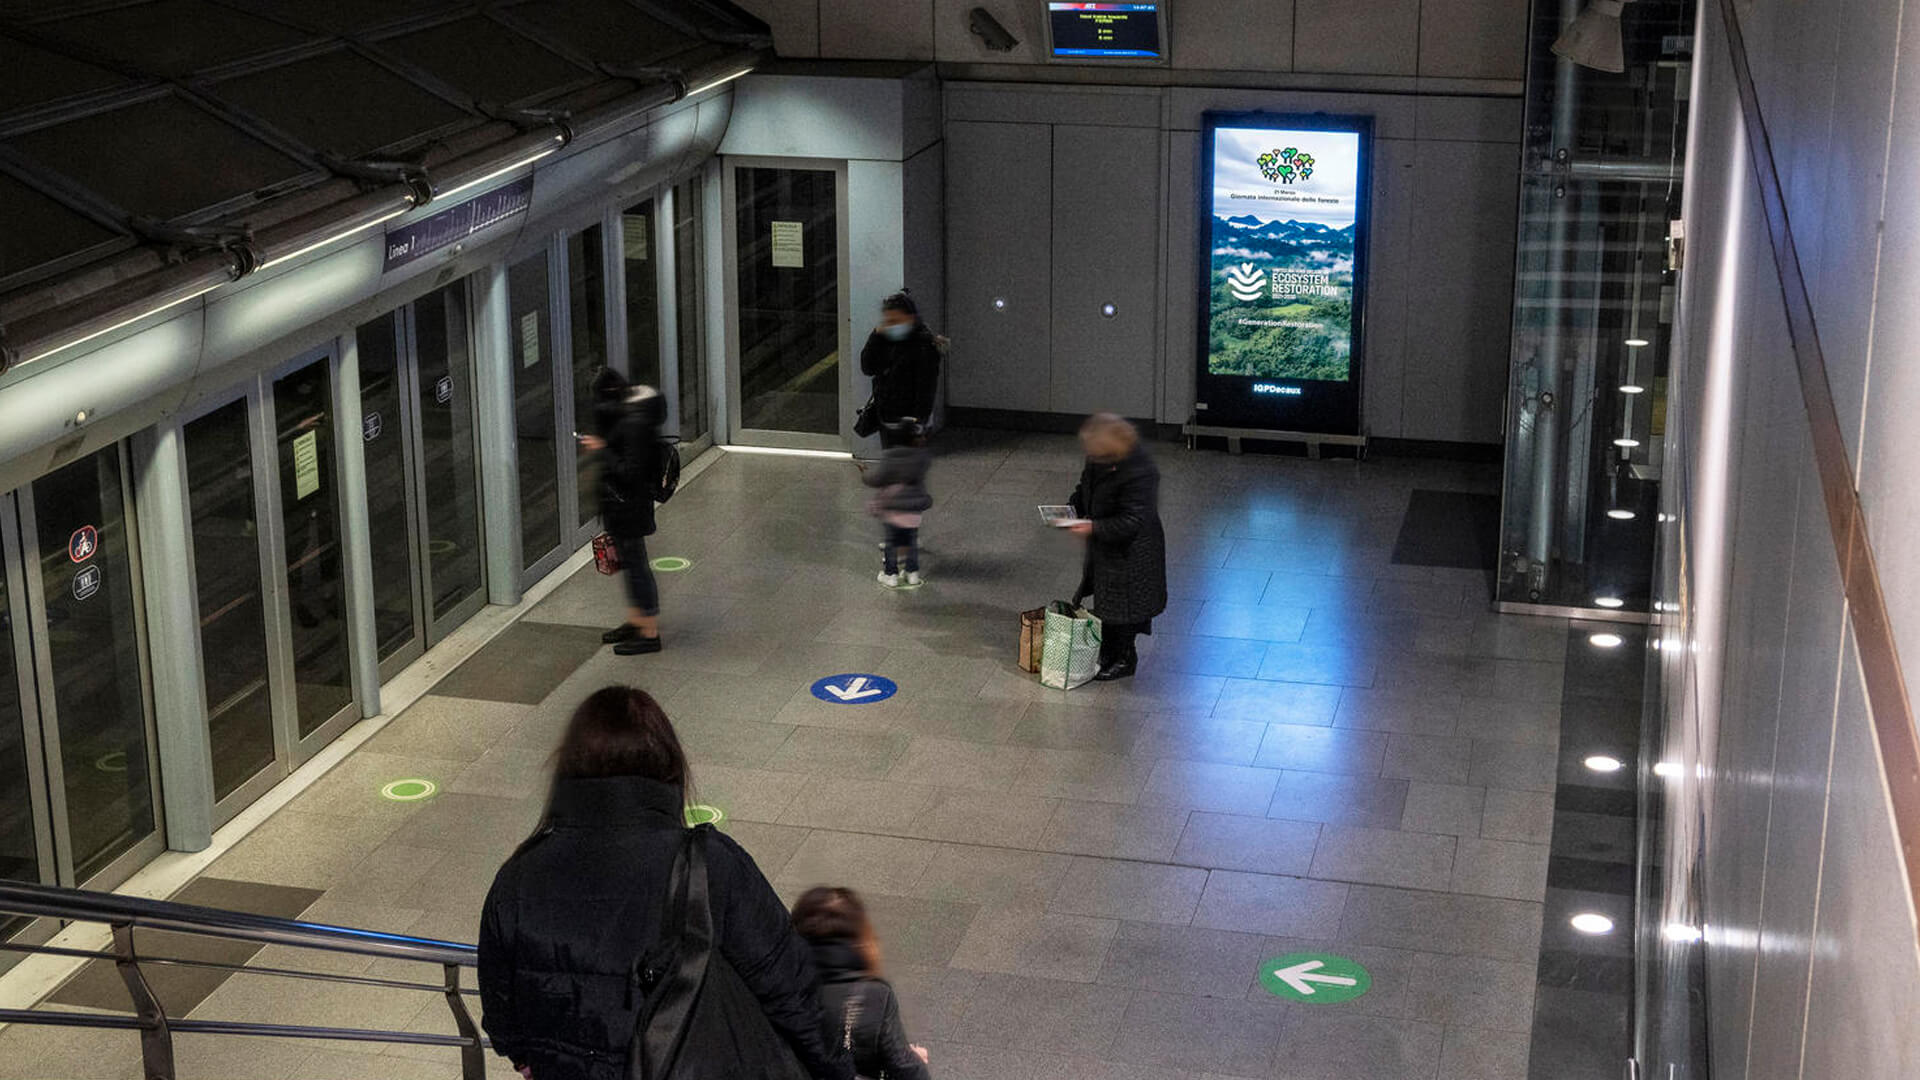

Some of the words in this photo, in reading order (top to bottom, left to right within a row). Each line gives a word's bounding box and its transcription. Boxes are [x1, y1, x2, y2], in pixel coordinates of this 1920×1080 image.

[1258, 194, 1300, 202] internazionale
[388, 242, 409, 260] Linea
[411, 235, 415, 249] 1
[1272, 272, 1329, 285] ECOSYSTEM
[1272, 283, 1338, 296] RESTORATION
[1238, 318, 1324, 329] #GenerationRestoration
[1254, 383, 1301, 395] IGPDecaux
